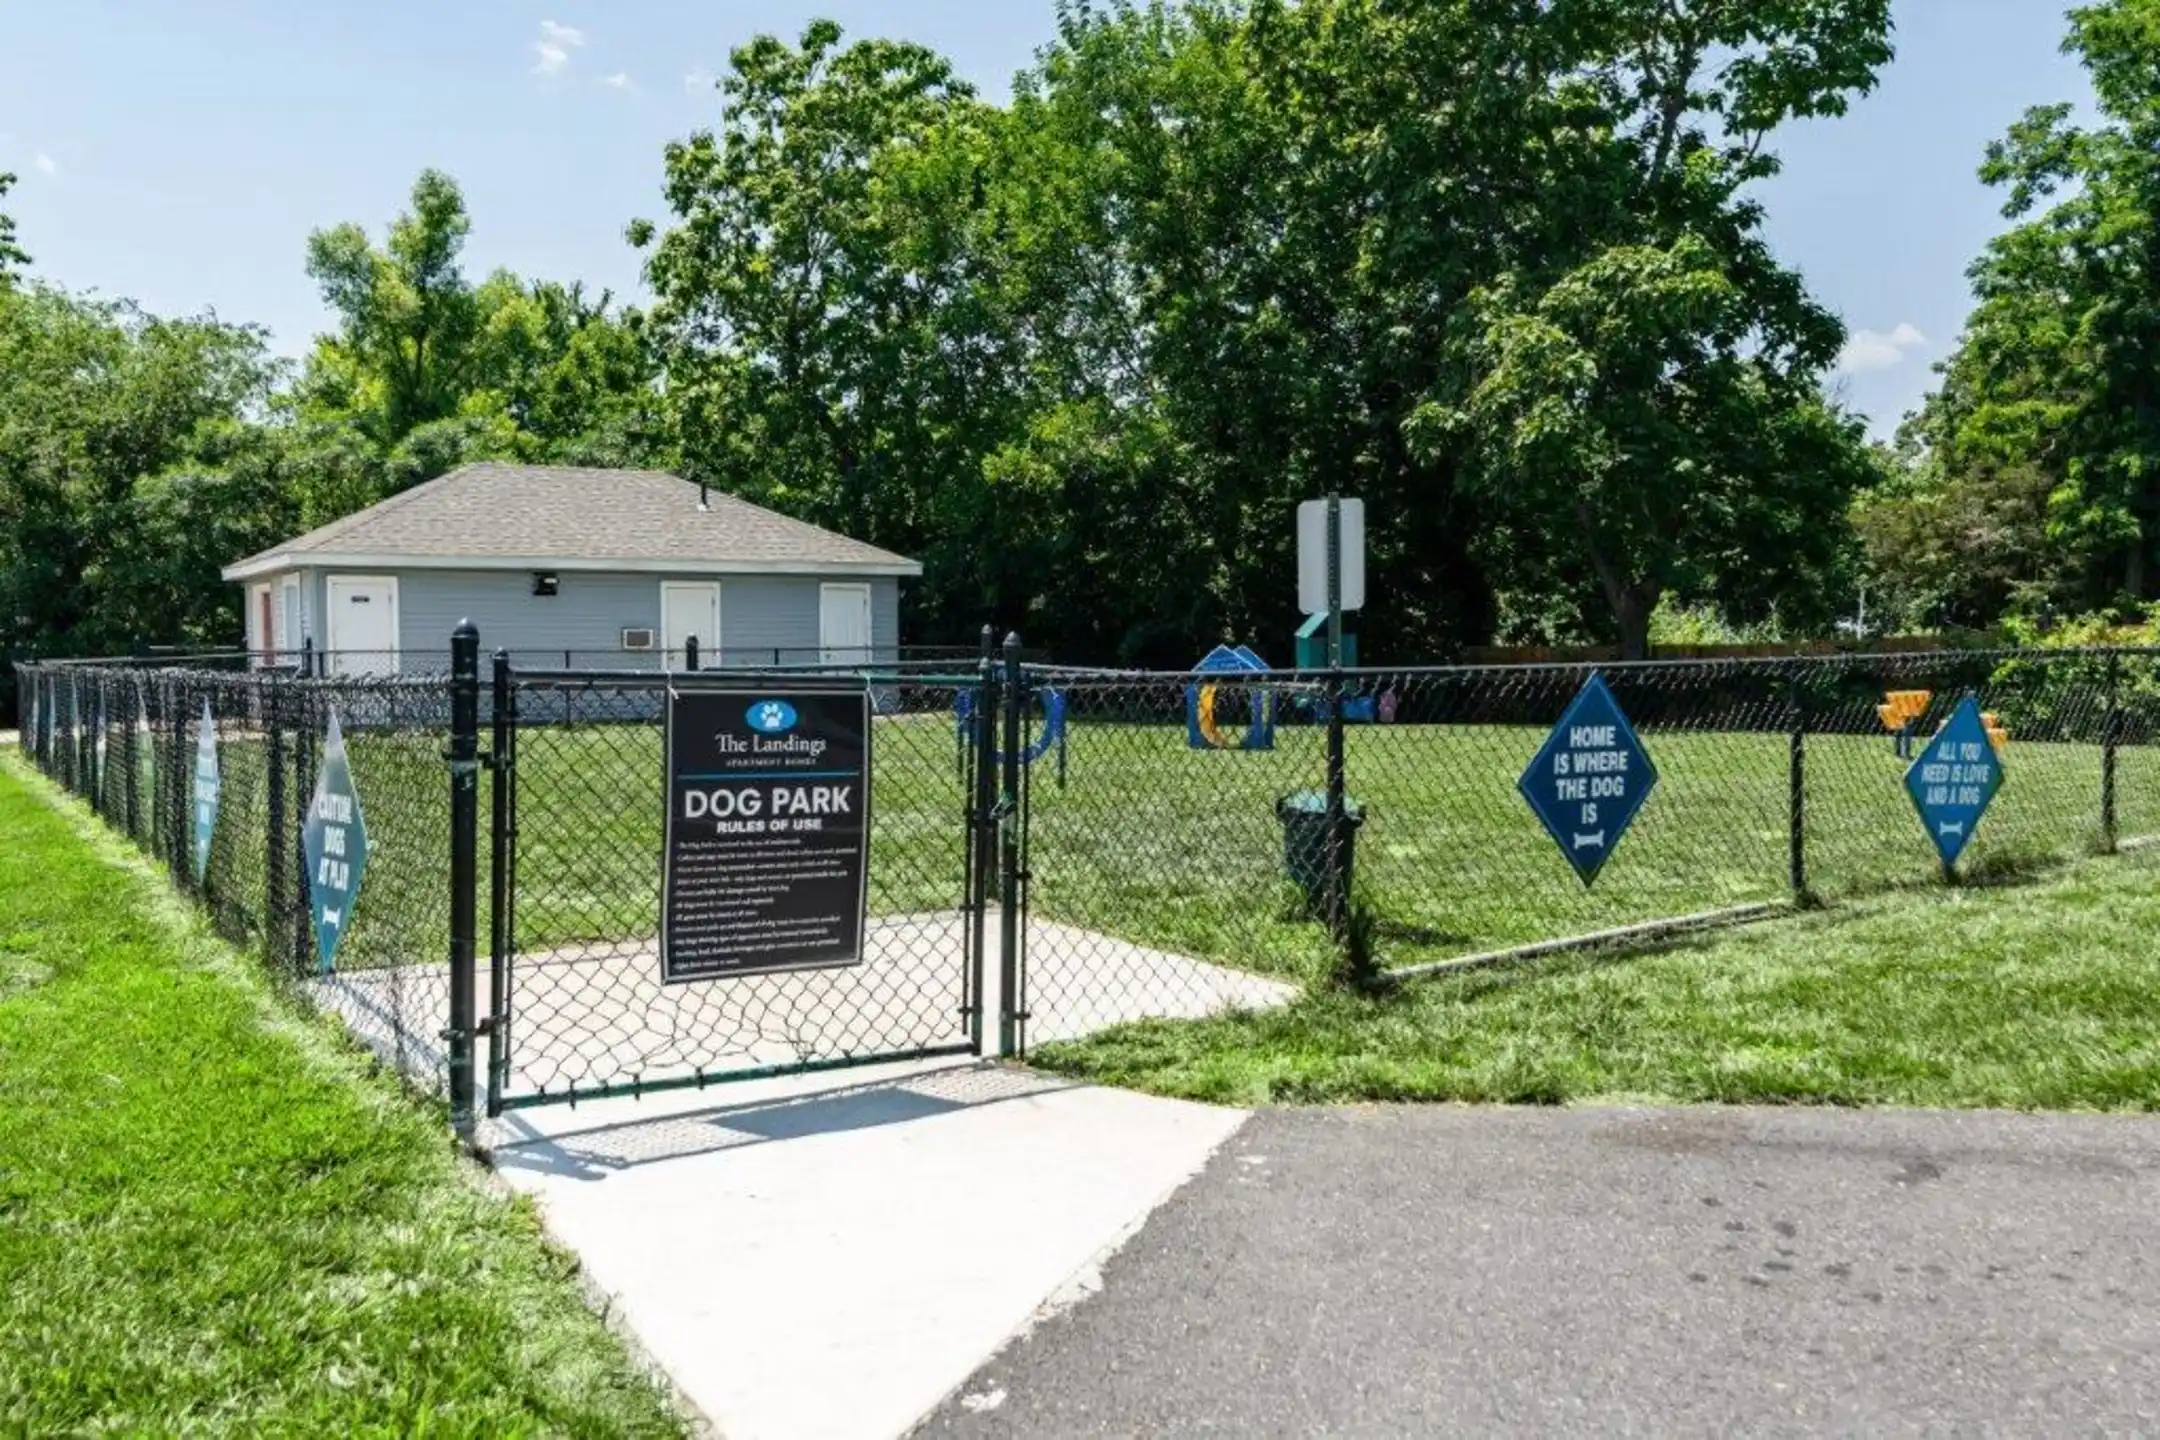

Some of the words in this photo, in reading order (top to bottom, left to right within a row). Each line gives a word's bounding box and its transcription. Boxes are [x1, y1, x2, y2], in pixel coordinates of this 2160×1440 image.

[715, 733, 749, 753] The
[752, 733, 827, 756] Landings
[1569, 725, 1617, 748] HOME
[725, 757, 781, 768] APARTMENT
[1553, 752, 1570, 775] IS
[1573, 750, 1629, 773] WHERE
[1936, 740, 1957, 761] ALL
[1960, 742, 1982, 762] YOU
[1921, 763, 1950, 783] NEED
[1951, 763, 1962, 783] IS
[1963, 763, 1991, 784] LOVE
[1555, 777, 1588, 801] THE
[1590, 775, 1625, 798] DOG
[1925, 785, 1949, 805] AND
[1948, 785, 1957, 805] A
[1958, 785, 1981, 805] DOG
[684, 787, 763, 818] DOG
[771, 785, 852, 816] PARK
[1581, 801, 1598, 824] IS
[716, 820, 766, 834] RULES
[768, 818, 790, 832] OF
[792, 817, 823, 832] USE
